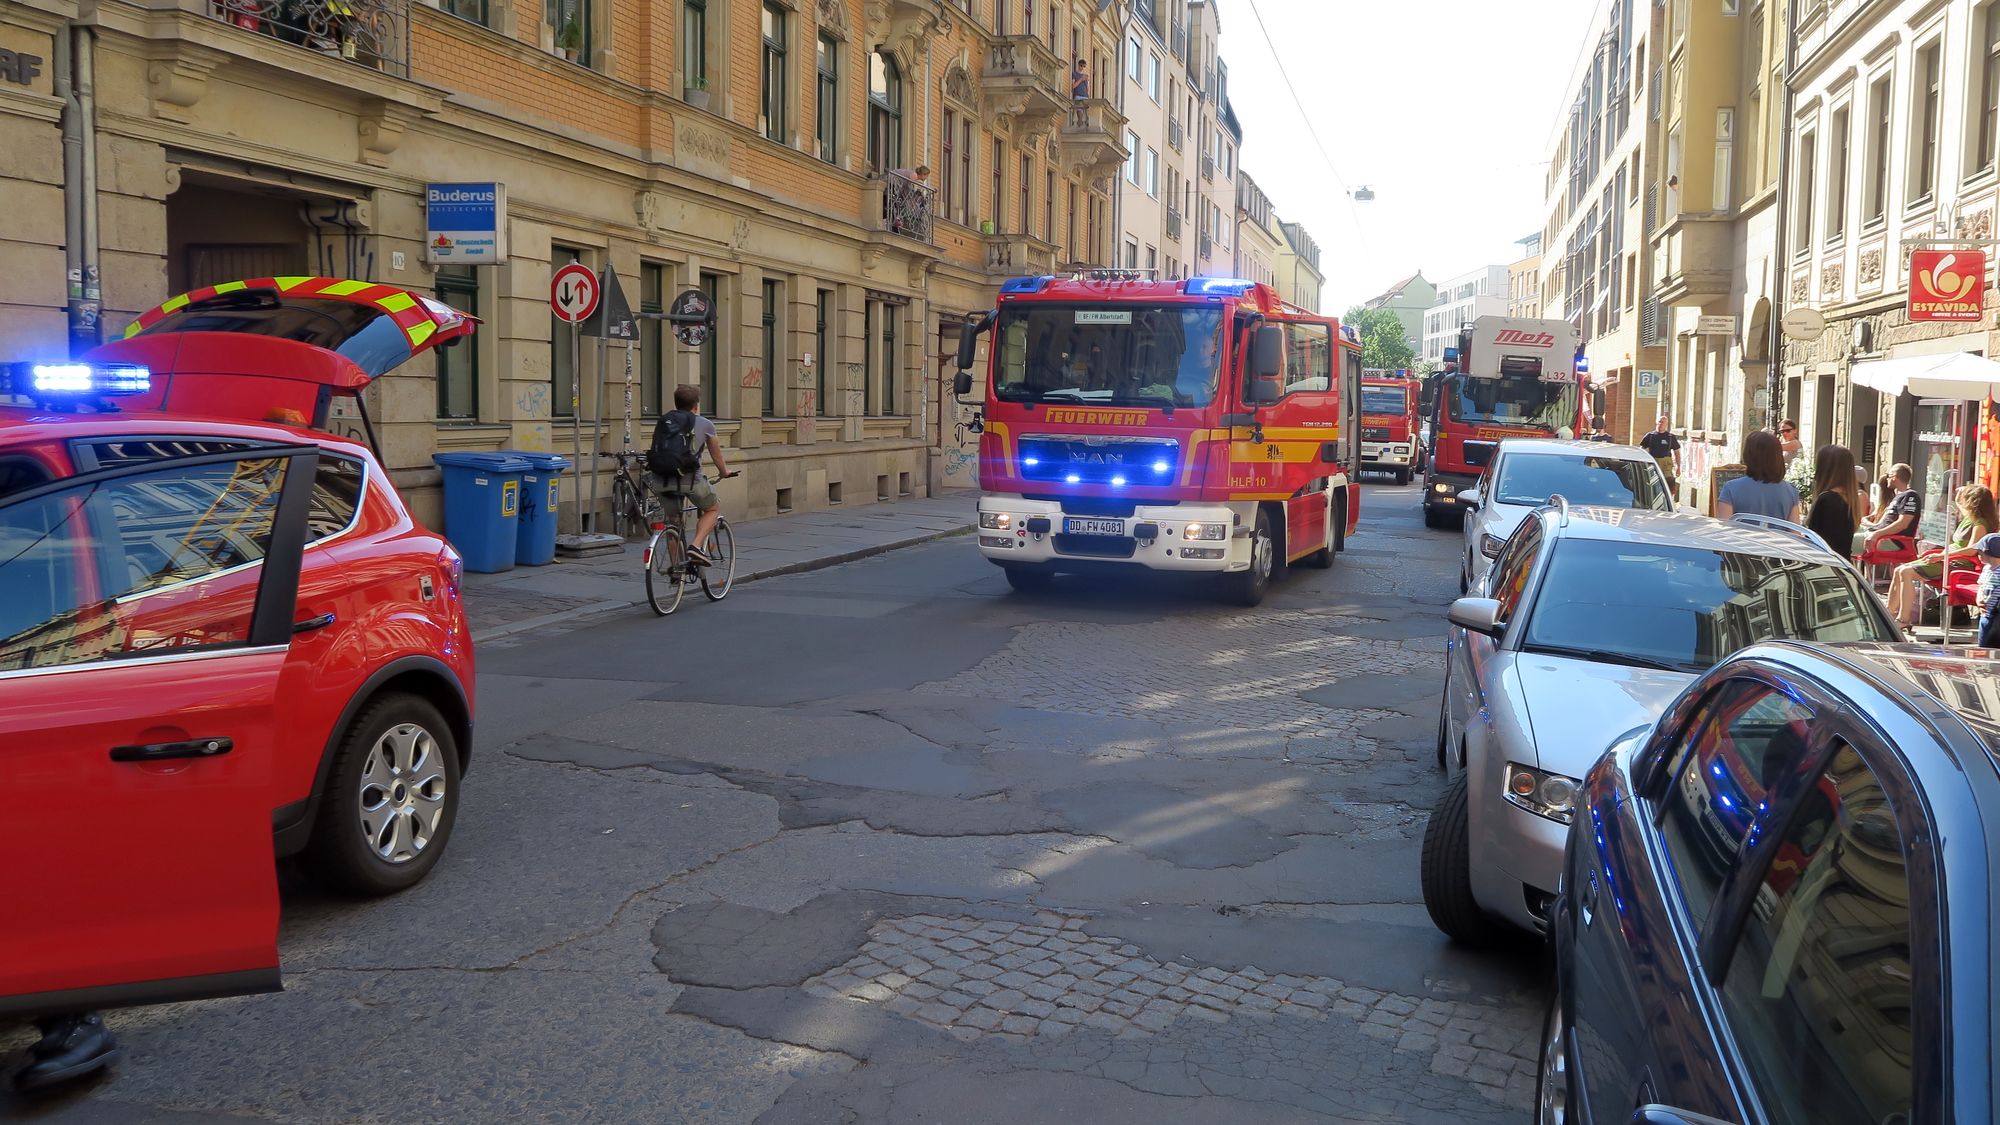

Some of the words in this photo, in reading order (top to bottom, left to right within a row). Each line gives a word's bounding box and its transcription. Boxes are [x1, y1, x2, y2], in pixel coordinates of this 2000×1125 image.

[428, 189, 495, 202] Buderus
[1912, 303, 1979, 312] ESTAVIDA
[1493, 329, 1554, 348] Metz
[1553, 371, 1566, 380] 32
[1045, 407, 1150, 426] FEUERWEHR
[1068, 452, 1123, 464] MAN
[1230, 476, 1253, 488] HLF
[1255, 476, 1267, 488] 10
[1069, 520, 1081, 531] DD
[1086, 521, 1099, 532] FW
[1100, 522, 1122, 533] 4081
